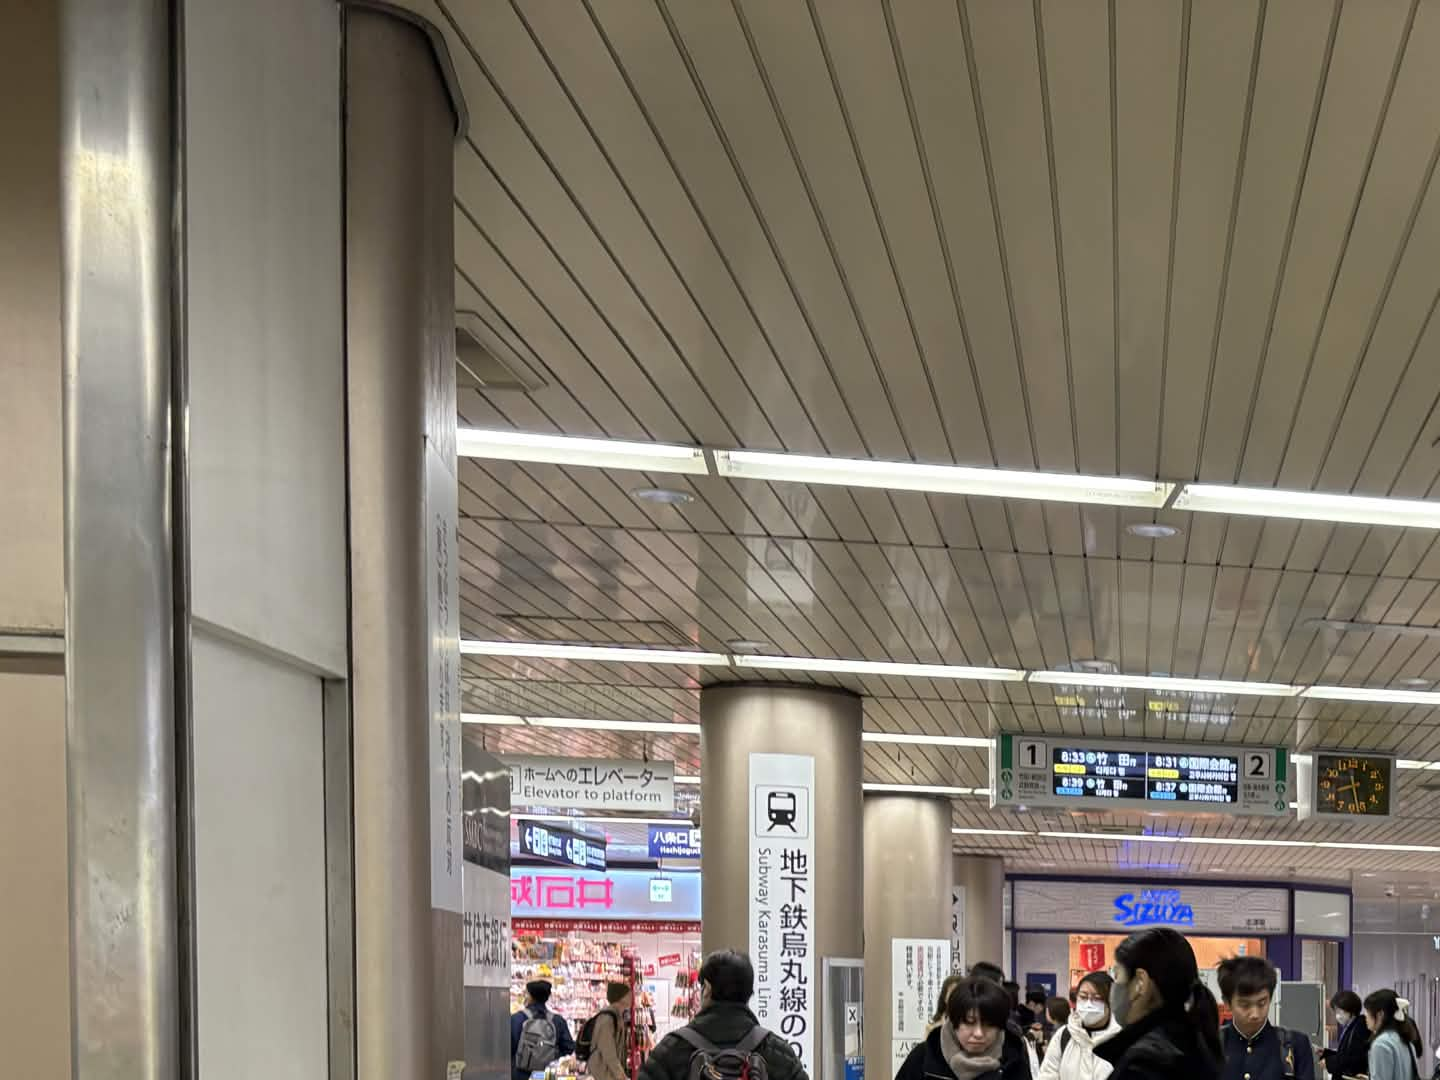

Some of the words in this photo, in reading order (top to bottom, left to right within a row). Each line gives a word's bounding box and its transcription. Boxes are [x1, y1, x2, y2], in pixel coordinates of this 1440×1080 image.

[1026, 744, 1037, 766] 1
[1061, 751, 1085, 763] 8:33
[1155, 756, 1177, 768] 8:31
[1250, 755, 1265, 776] 2
[524, 767, 669, 788] ホームへのエレベーター
[524, 786, 579, 799] Elevator
[585, 788, 599, 799] to
[602, 788, 662, 803] platform
[653, 831, 688, 845] 八条口
[756, 847, 771, 906] Subway
[1114, 893, 1195, 927] SIZUYA
[757, 910, 771, 983] Karasuma
[779, 848, 808, 1070] 地下鉄烏丸線の
[757, 989, 771, 1019] Line
